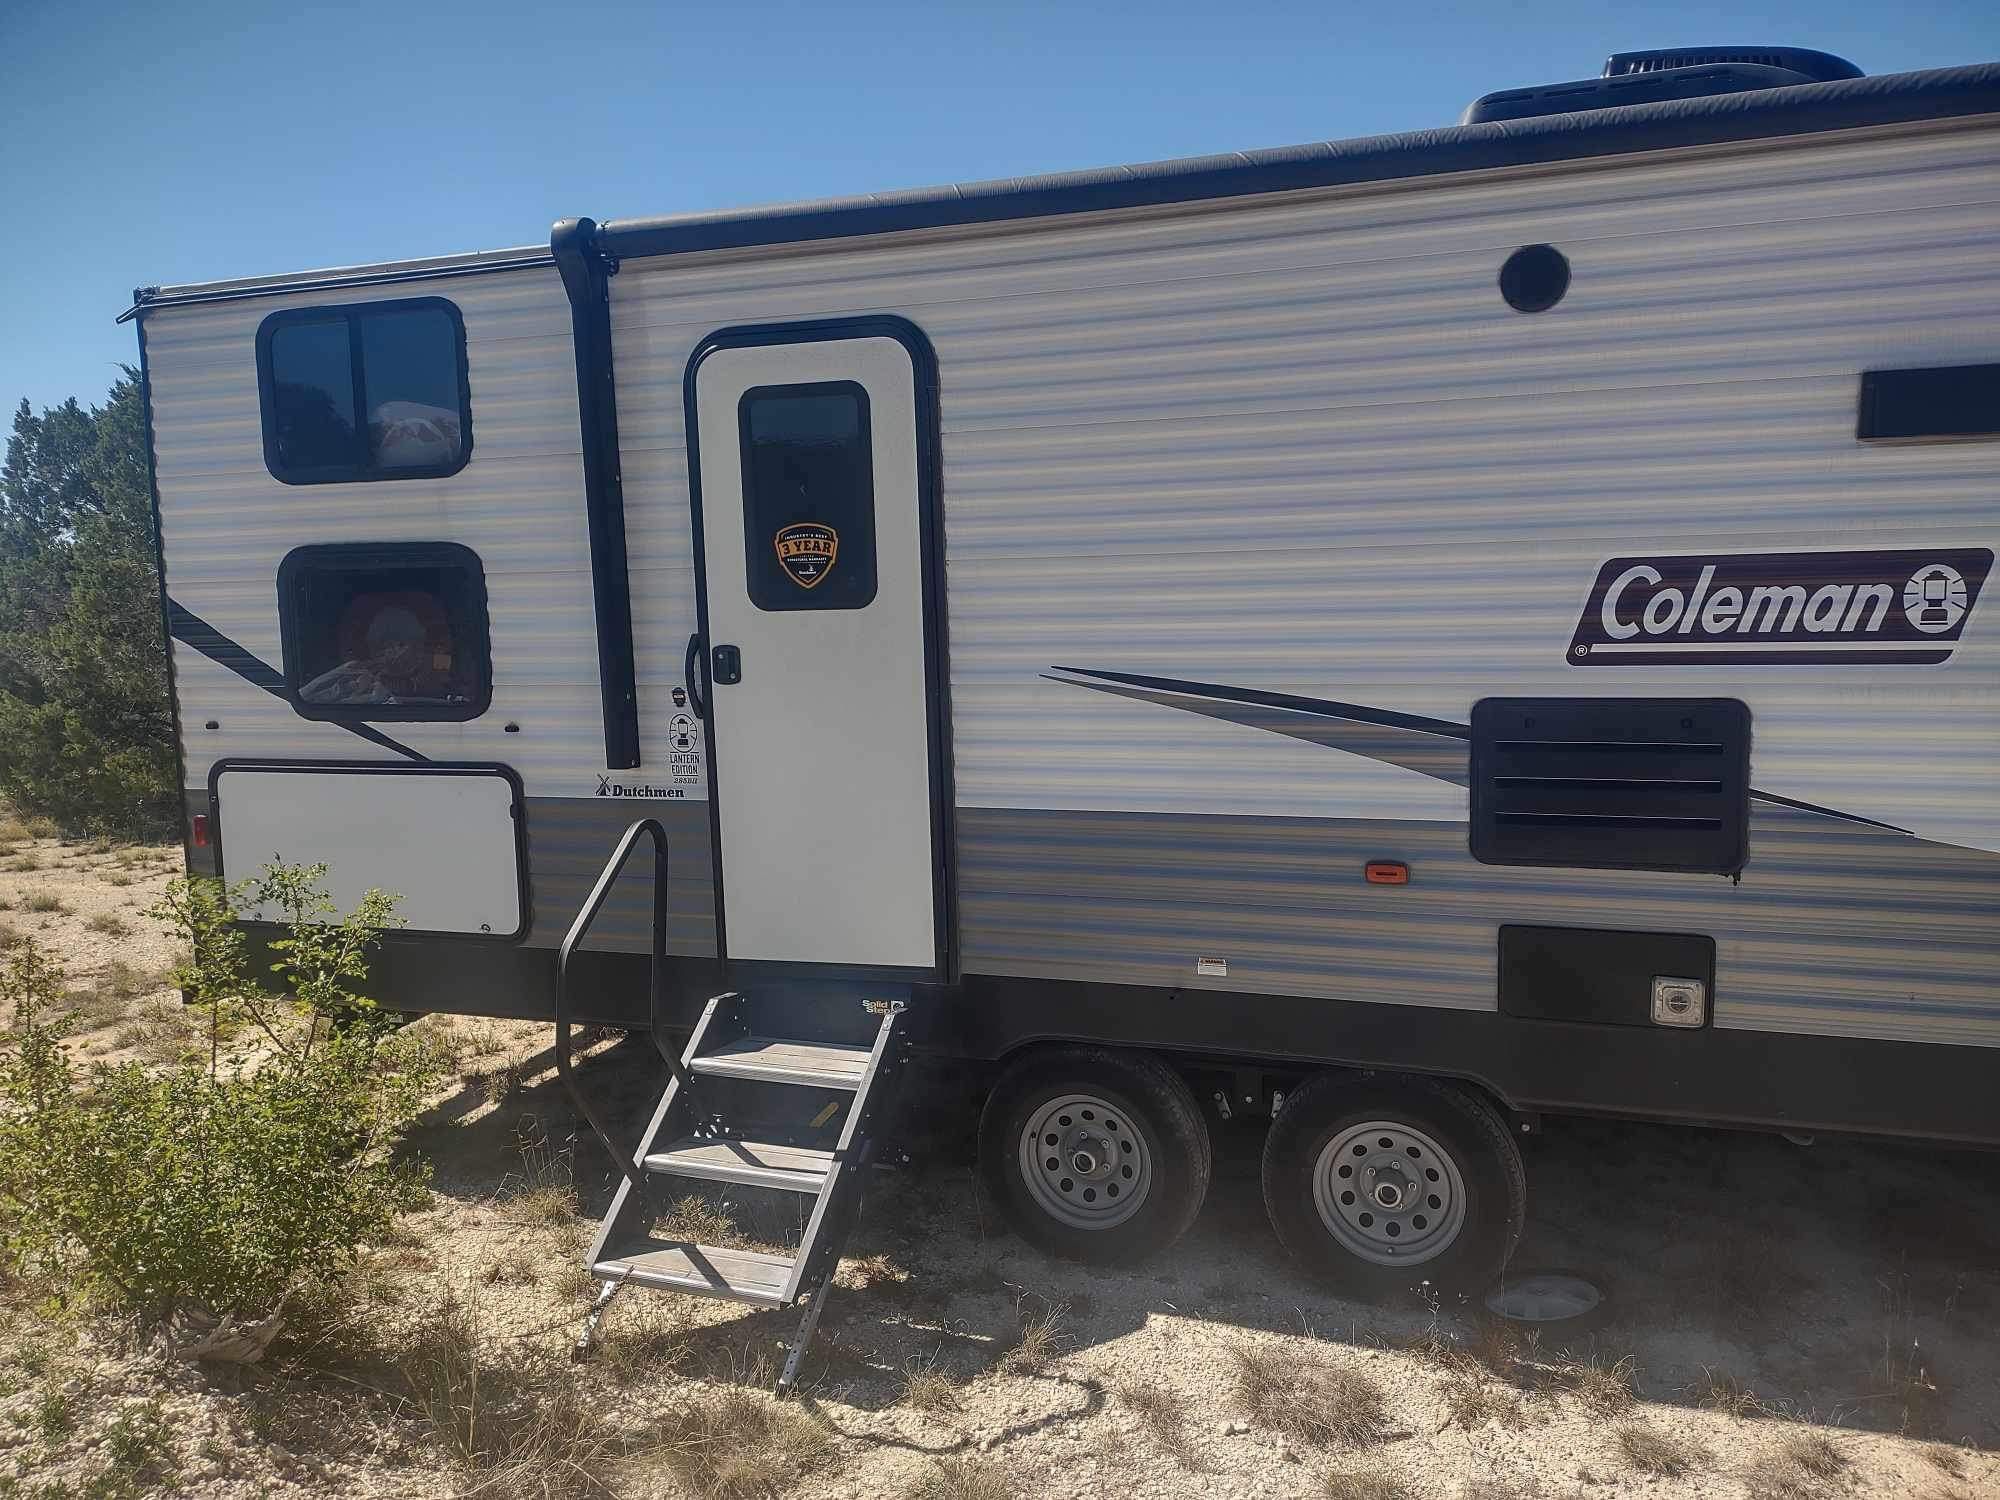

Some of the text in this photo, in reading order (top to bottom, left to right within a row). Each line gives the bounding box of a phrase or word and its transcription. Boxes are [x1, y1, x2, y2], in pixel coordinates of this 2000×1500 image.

[782, 540, 832, 555] 3 YEAR
[1601, 564, 1895, 640] Coleman
[670, 754, 700, 764] LANTERN
[671, 765, 698, 775] EDITION
[612, 784, 685, 798] Dutchmen
[862, 999, 888, 1008] Solid
[866, 1006, 891, 1016] Step
